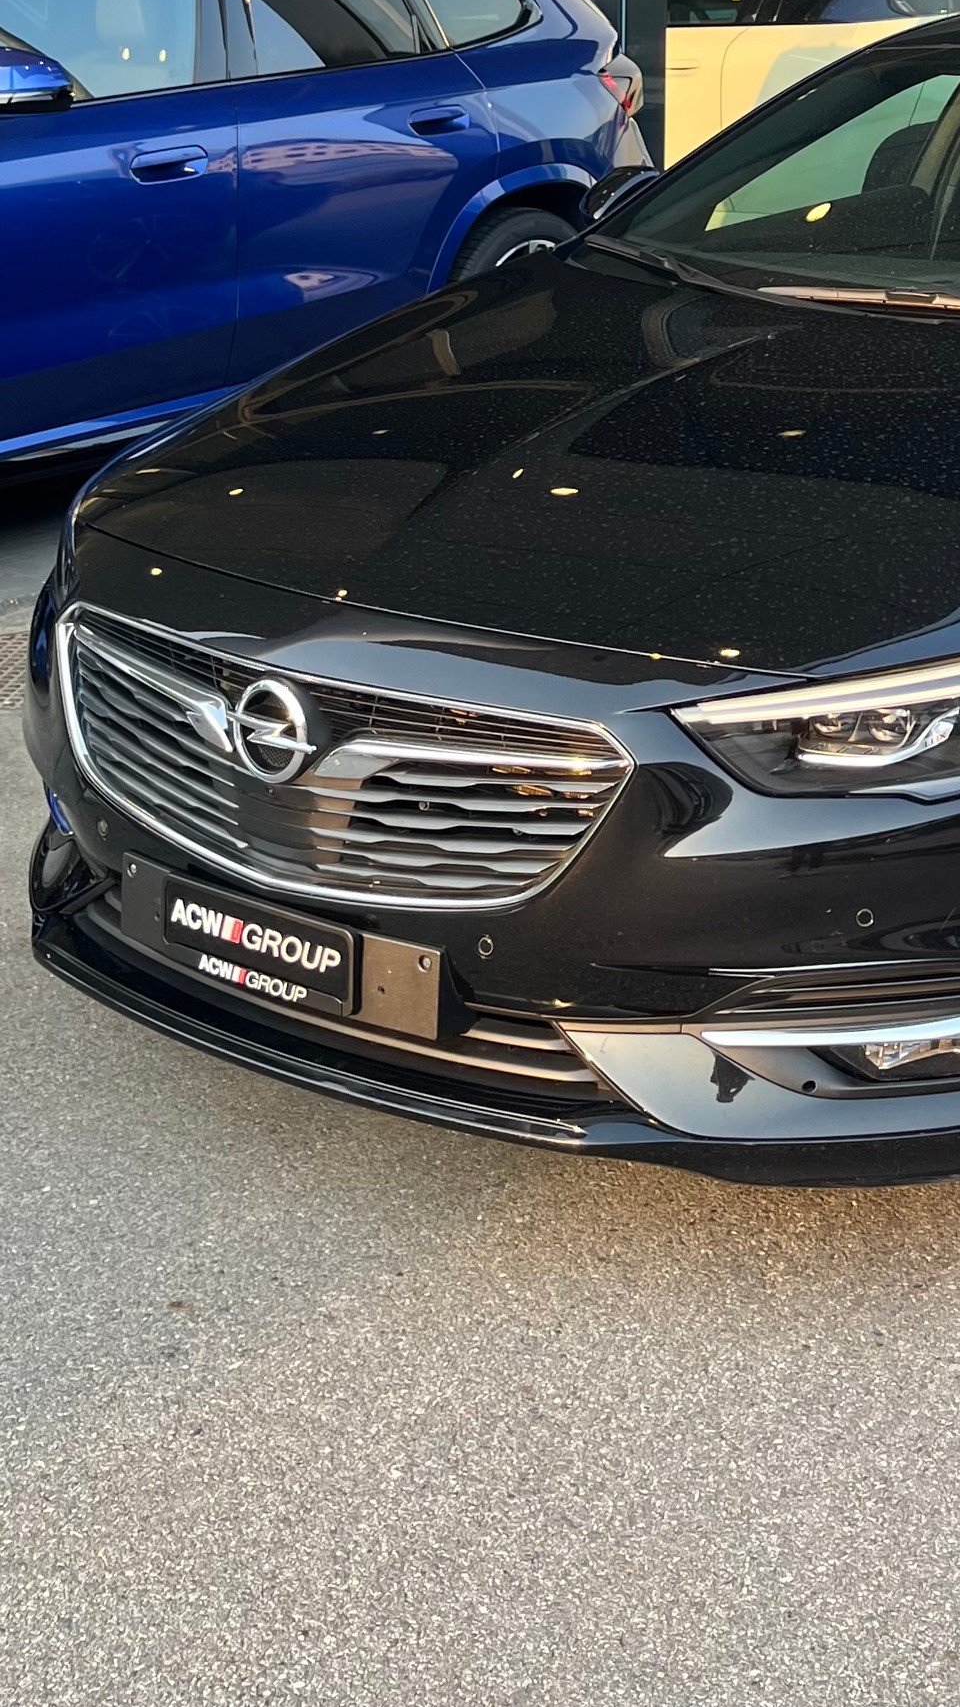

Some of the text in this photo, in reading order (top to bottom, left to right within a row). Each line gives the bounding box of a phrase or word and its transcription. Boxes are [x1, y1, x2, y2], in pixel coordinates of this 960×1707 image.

[170, 898, 342, 973] ACW GROUP
[198, 954, 308, 1003] ACW GROUP
